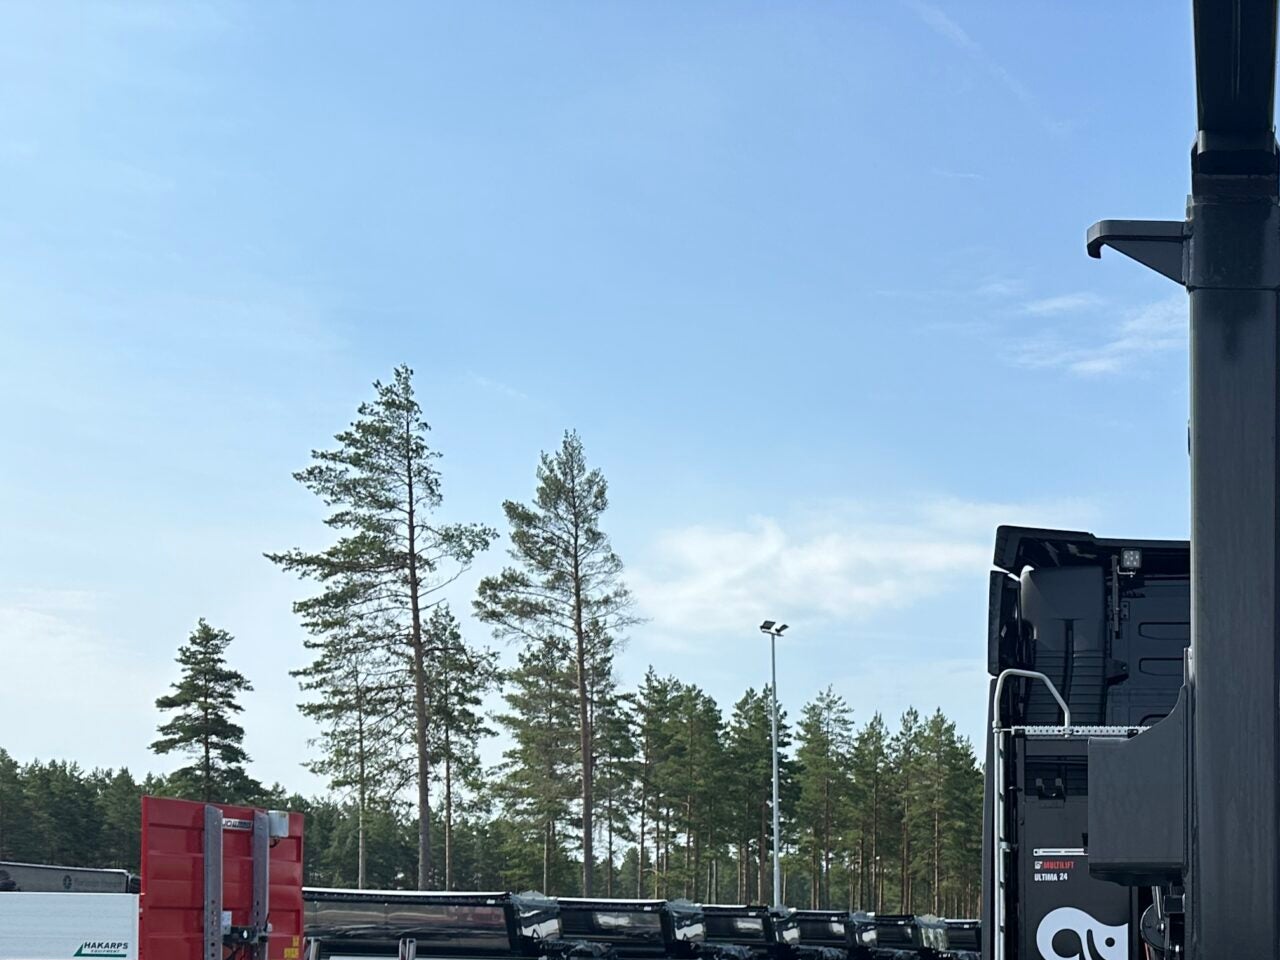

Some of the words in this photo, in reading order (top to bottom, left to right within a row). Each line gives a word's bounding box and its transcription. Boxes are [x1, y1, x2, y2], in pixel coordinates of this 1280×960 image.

[1043, 861, 1074, 869] MULTILIFT
[1034, 873, 1058, 881] ULTIMA
[1059, 872, 1068, 880] 24
[84, 941, 129, 949] HAKARPS
